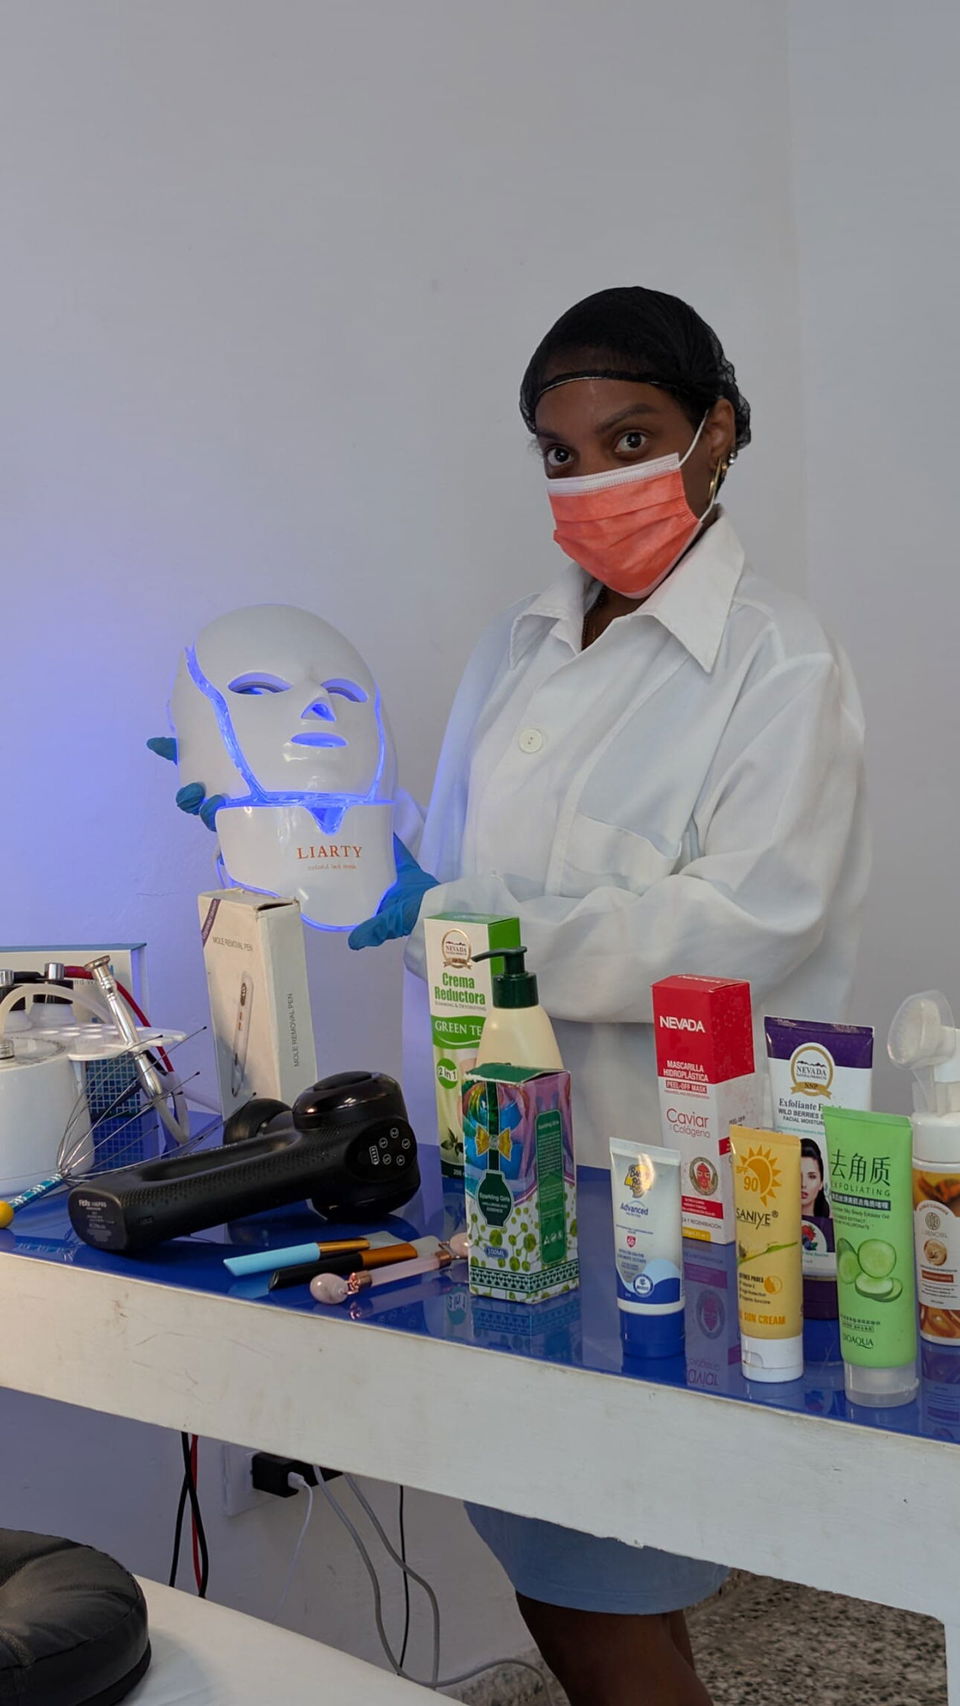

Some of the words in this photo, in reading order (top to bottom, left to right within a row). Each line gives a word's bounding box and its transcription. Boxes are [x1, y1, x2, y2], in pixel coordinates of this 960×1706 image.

[296, 844, 363, 860] LIARTY
[445, 945, 468, 953] NEVADA
[442, 972, 475, 989] Crema
[434, 986, 486, 1005] Reductora
[289, 1010, 297, 1048] REMOVAL
[434, 1020, 468, 1035] GREEN
[469, 1024, 483, 1037] TE
[659, 1015, 706, 1033] NEVADA
[291, 1048, 299, 1068] MOLE
[438, 1067, 444, 1076] 2
[444, 1069, 451, 1079] in
[452, 1070, 457, 1080] 1
[666, 1060, 705, 1073] MASCARILLA
[796, 1066, 828, 1077] NEVADA
[666, 1080, 691, 1091] PEEL-OFF
[691, 1084, 707, 1093] MASK
[779, 1098, 818, 1111] Exfoliante
[666, 1107, 710, 1128] Caviar
[778, 1108, 793, 1116] WILD
[793, 1110, 819, 1120] BERRIES
[783, 1116, 801, 1124] FACIAL
[830, 1148, 891, 1187] 去角质
[743, 1175, 759, 1192] 90
[620, 1202, 649, 1216] Advanced
[744, 1311, 757, 1323] SUN
[758, 1314, 786, 1325] CREAM
